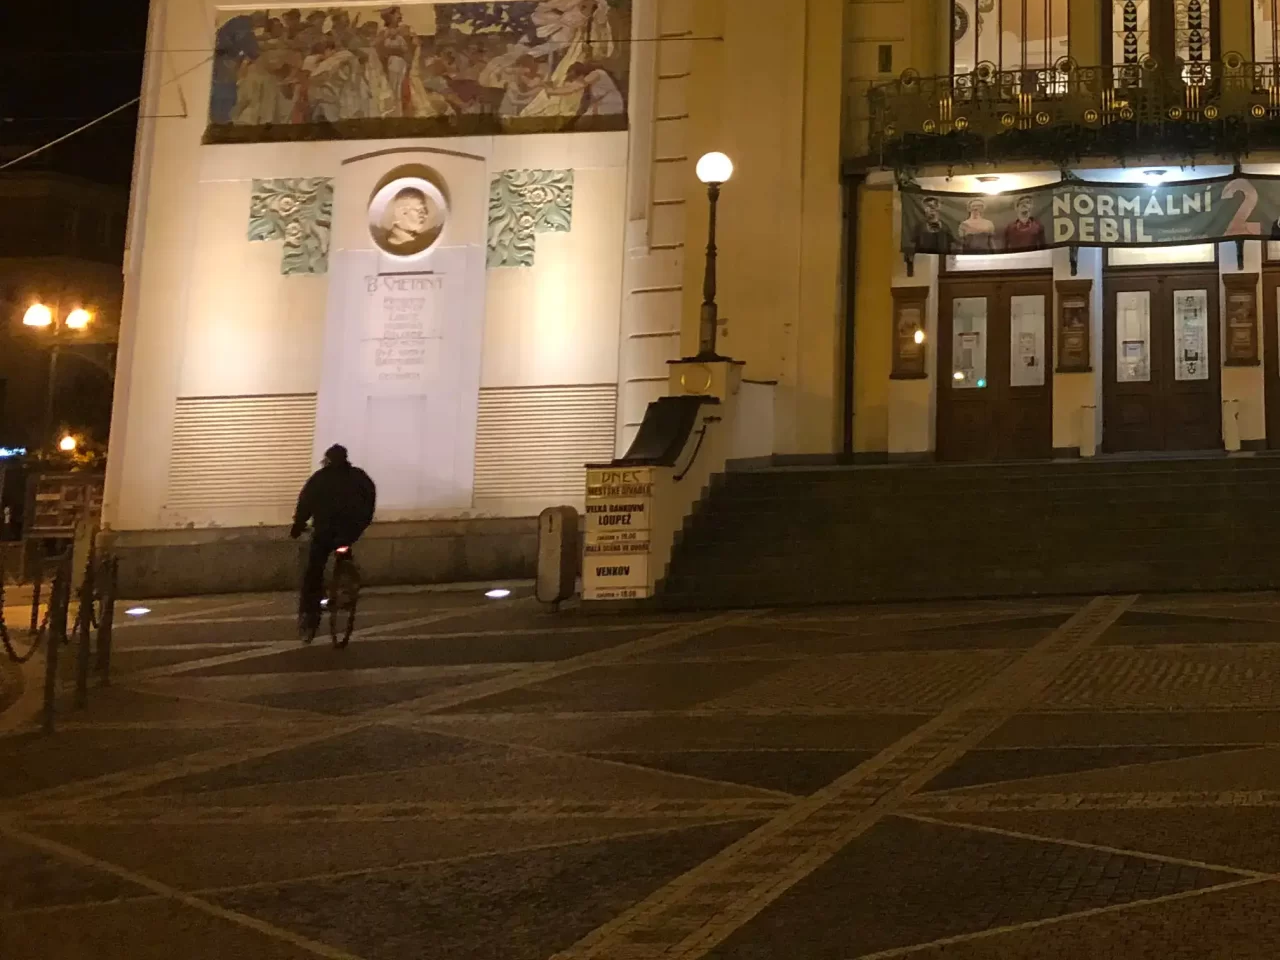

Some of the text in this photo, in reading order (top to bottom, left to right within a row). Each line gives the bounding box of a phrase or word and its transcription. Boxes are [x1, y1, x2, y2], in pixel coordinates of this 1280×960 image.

[1052, 178, 1261, 237] NORMÁLNÍ 2
[1053, 217, 1153, 242] DEBIL
[602, 470, 642, 483] DNES
[598, 513, 632, 526] LOUPEŽ
[596, 565, 630, 577] VENKOV
